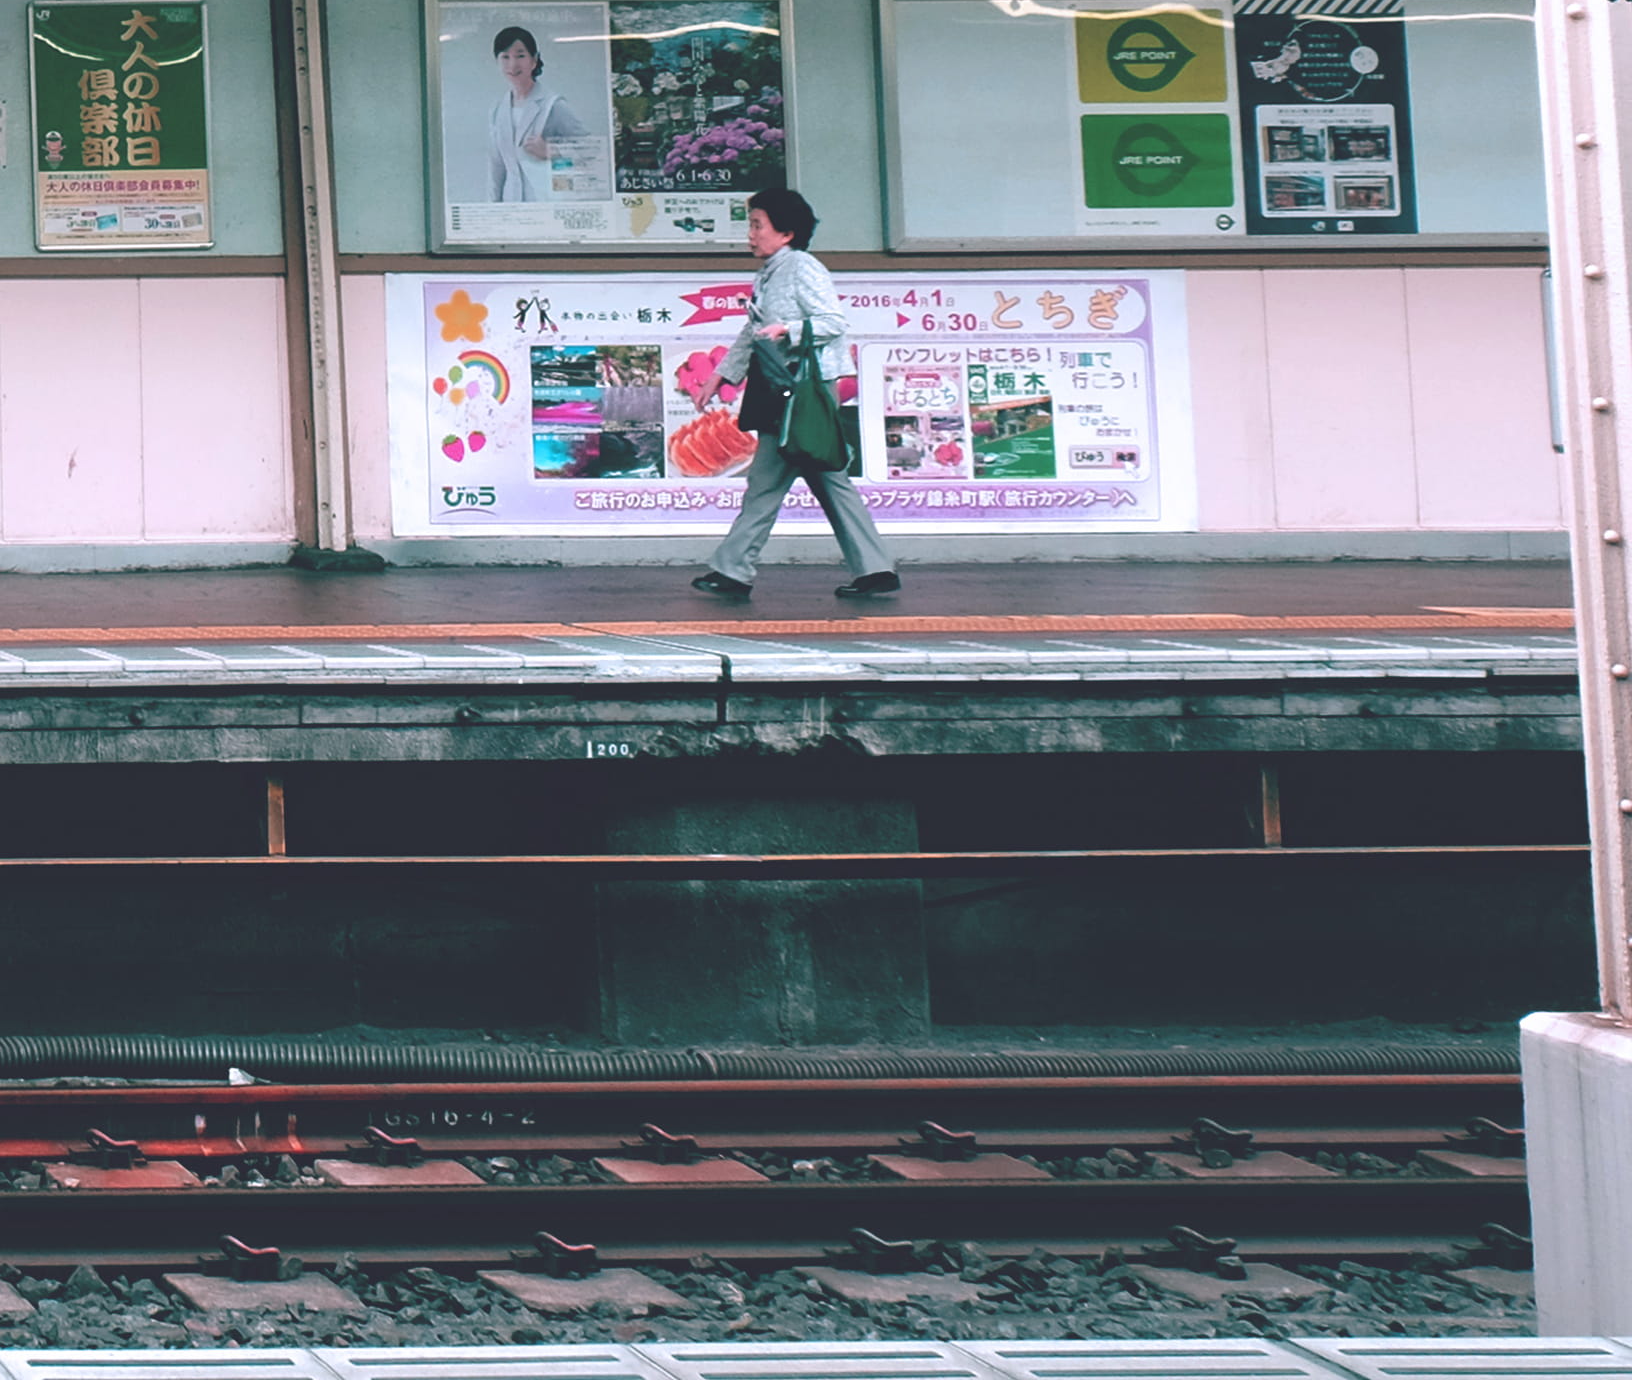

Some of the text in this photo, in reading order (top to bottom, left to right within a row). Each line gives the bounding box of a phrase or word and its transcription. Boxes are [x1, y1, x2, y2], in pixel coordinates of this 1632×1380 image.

[36, 10, 51, 20] JR
[1113, 51, 1177, 61] JRE POINT
[120, 9, 162, 166] 大人の休日
[77, 69, 121, 167] 倶楽部
[1119, 155, 1183, 165] JRE POINT
[46, 179, 201, 193] 大人の休日倶楽部会員募集中!
[620, 177, 675, 189] あじさい祭
[702, 295, 750, 310] 春の観
[850, 289, 955, 308] 2016年4月1日
[991, 284, 1128, 330] とちぎ
[560, 307, 672, 324] 本物の出会い 栃木
[921, 312, 989, 332] 6月30日
[886, 348, 1052, 364] パンフレットはこちら!
[1059, 351, 1113, 369] 列車で
[993, 371, 1046, 389] 栃木
[1072, 371, 1140, 389] 行こう!
[1074, 452, 1105, 462] びゅう
[441, 486, 497, 507] びゅう
[597, 743, 630, 756] 200
